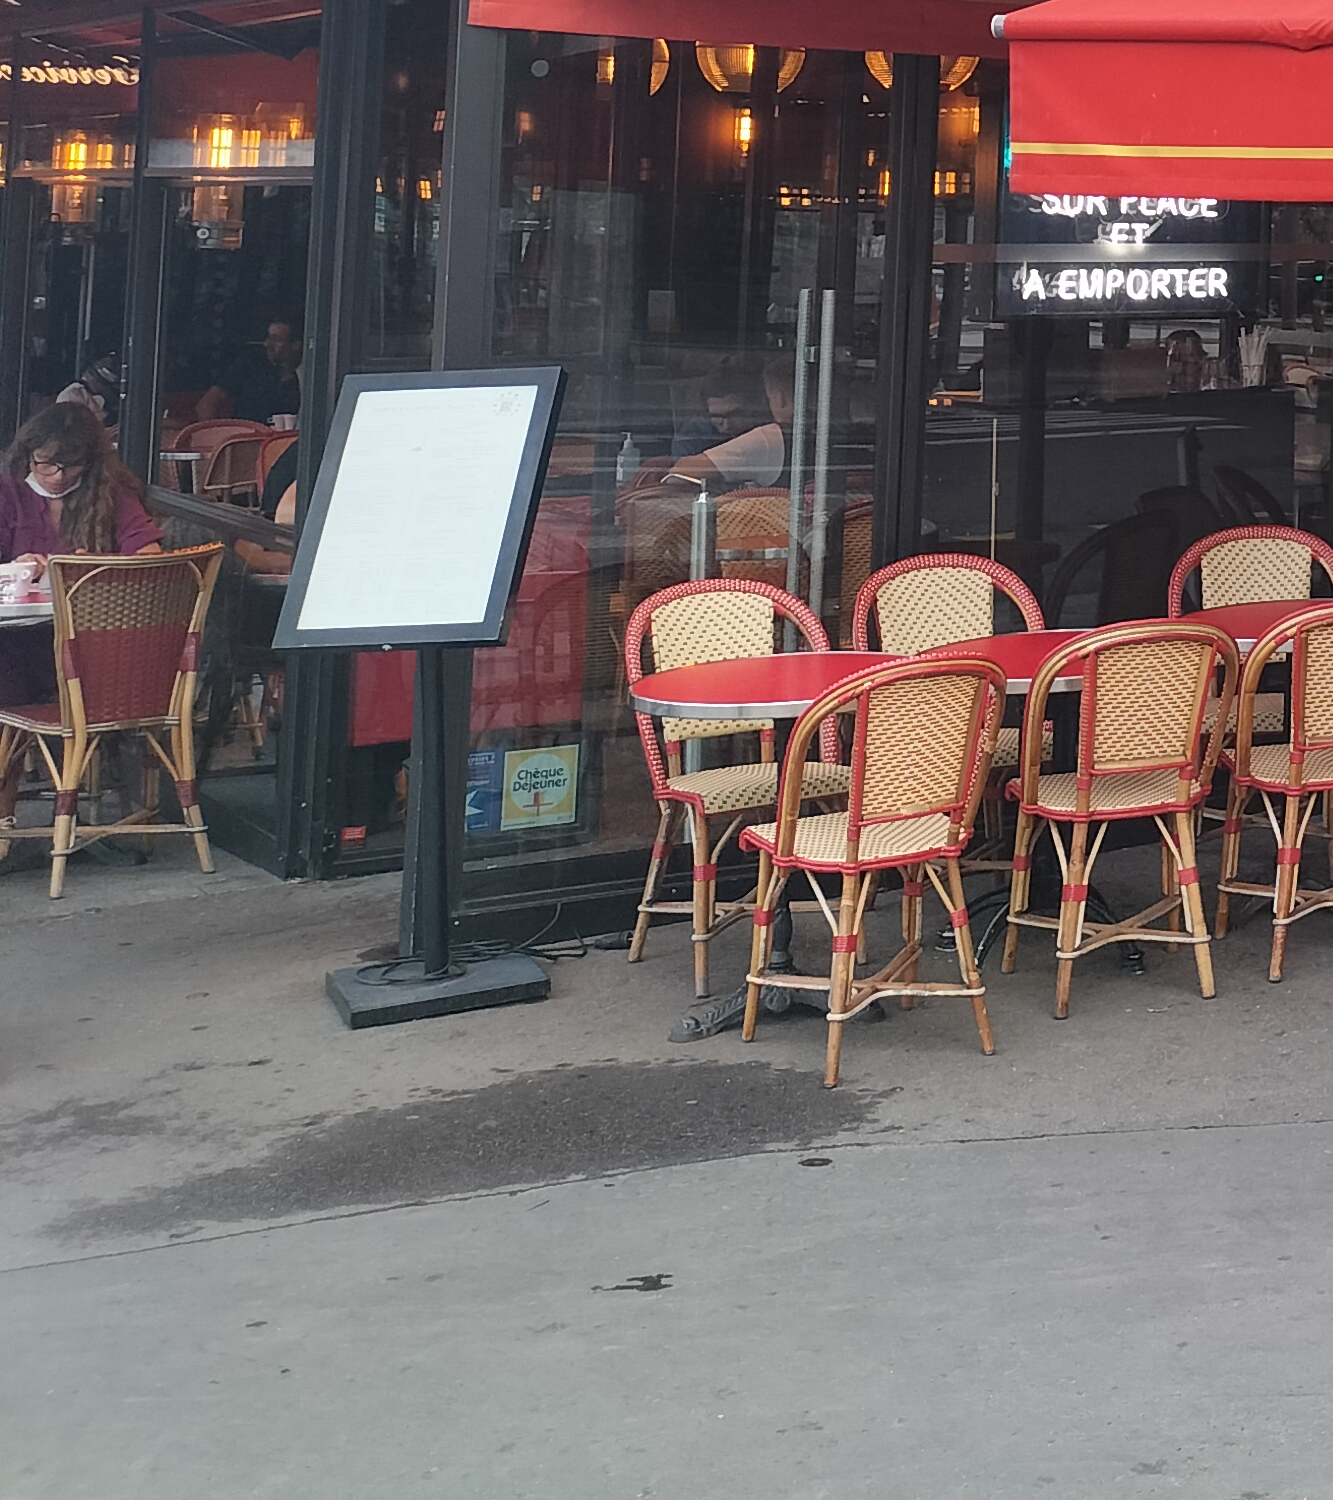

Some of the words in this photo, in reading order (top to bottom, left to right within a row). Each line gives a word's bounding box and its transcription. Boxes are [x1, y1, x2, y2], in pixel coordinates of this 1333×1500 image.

[1040, 193, 1108, 217] SUR
[1120, 195, 1219, 218] PLACE
[1057, 267, 1229, 300] EMPORTER
